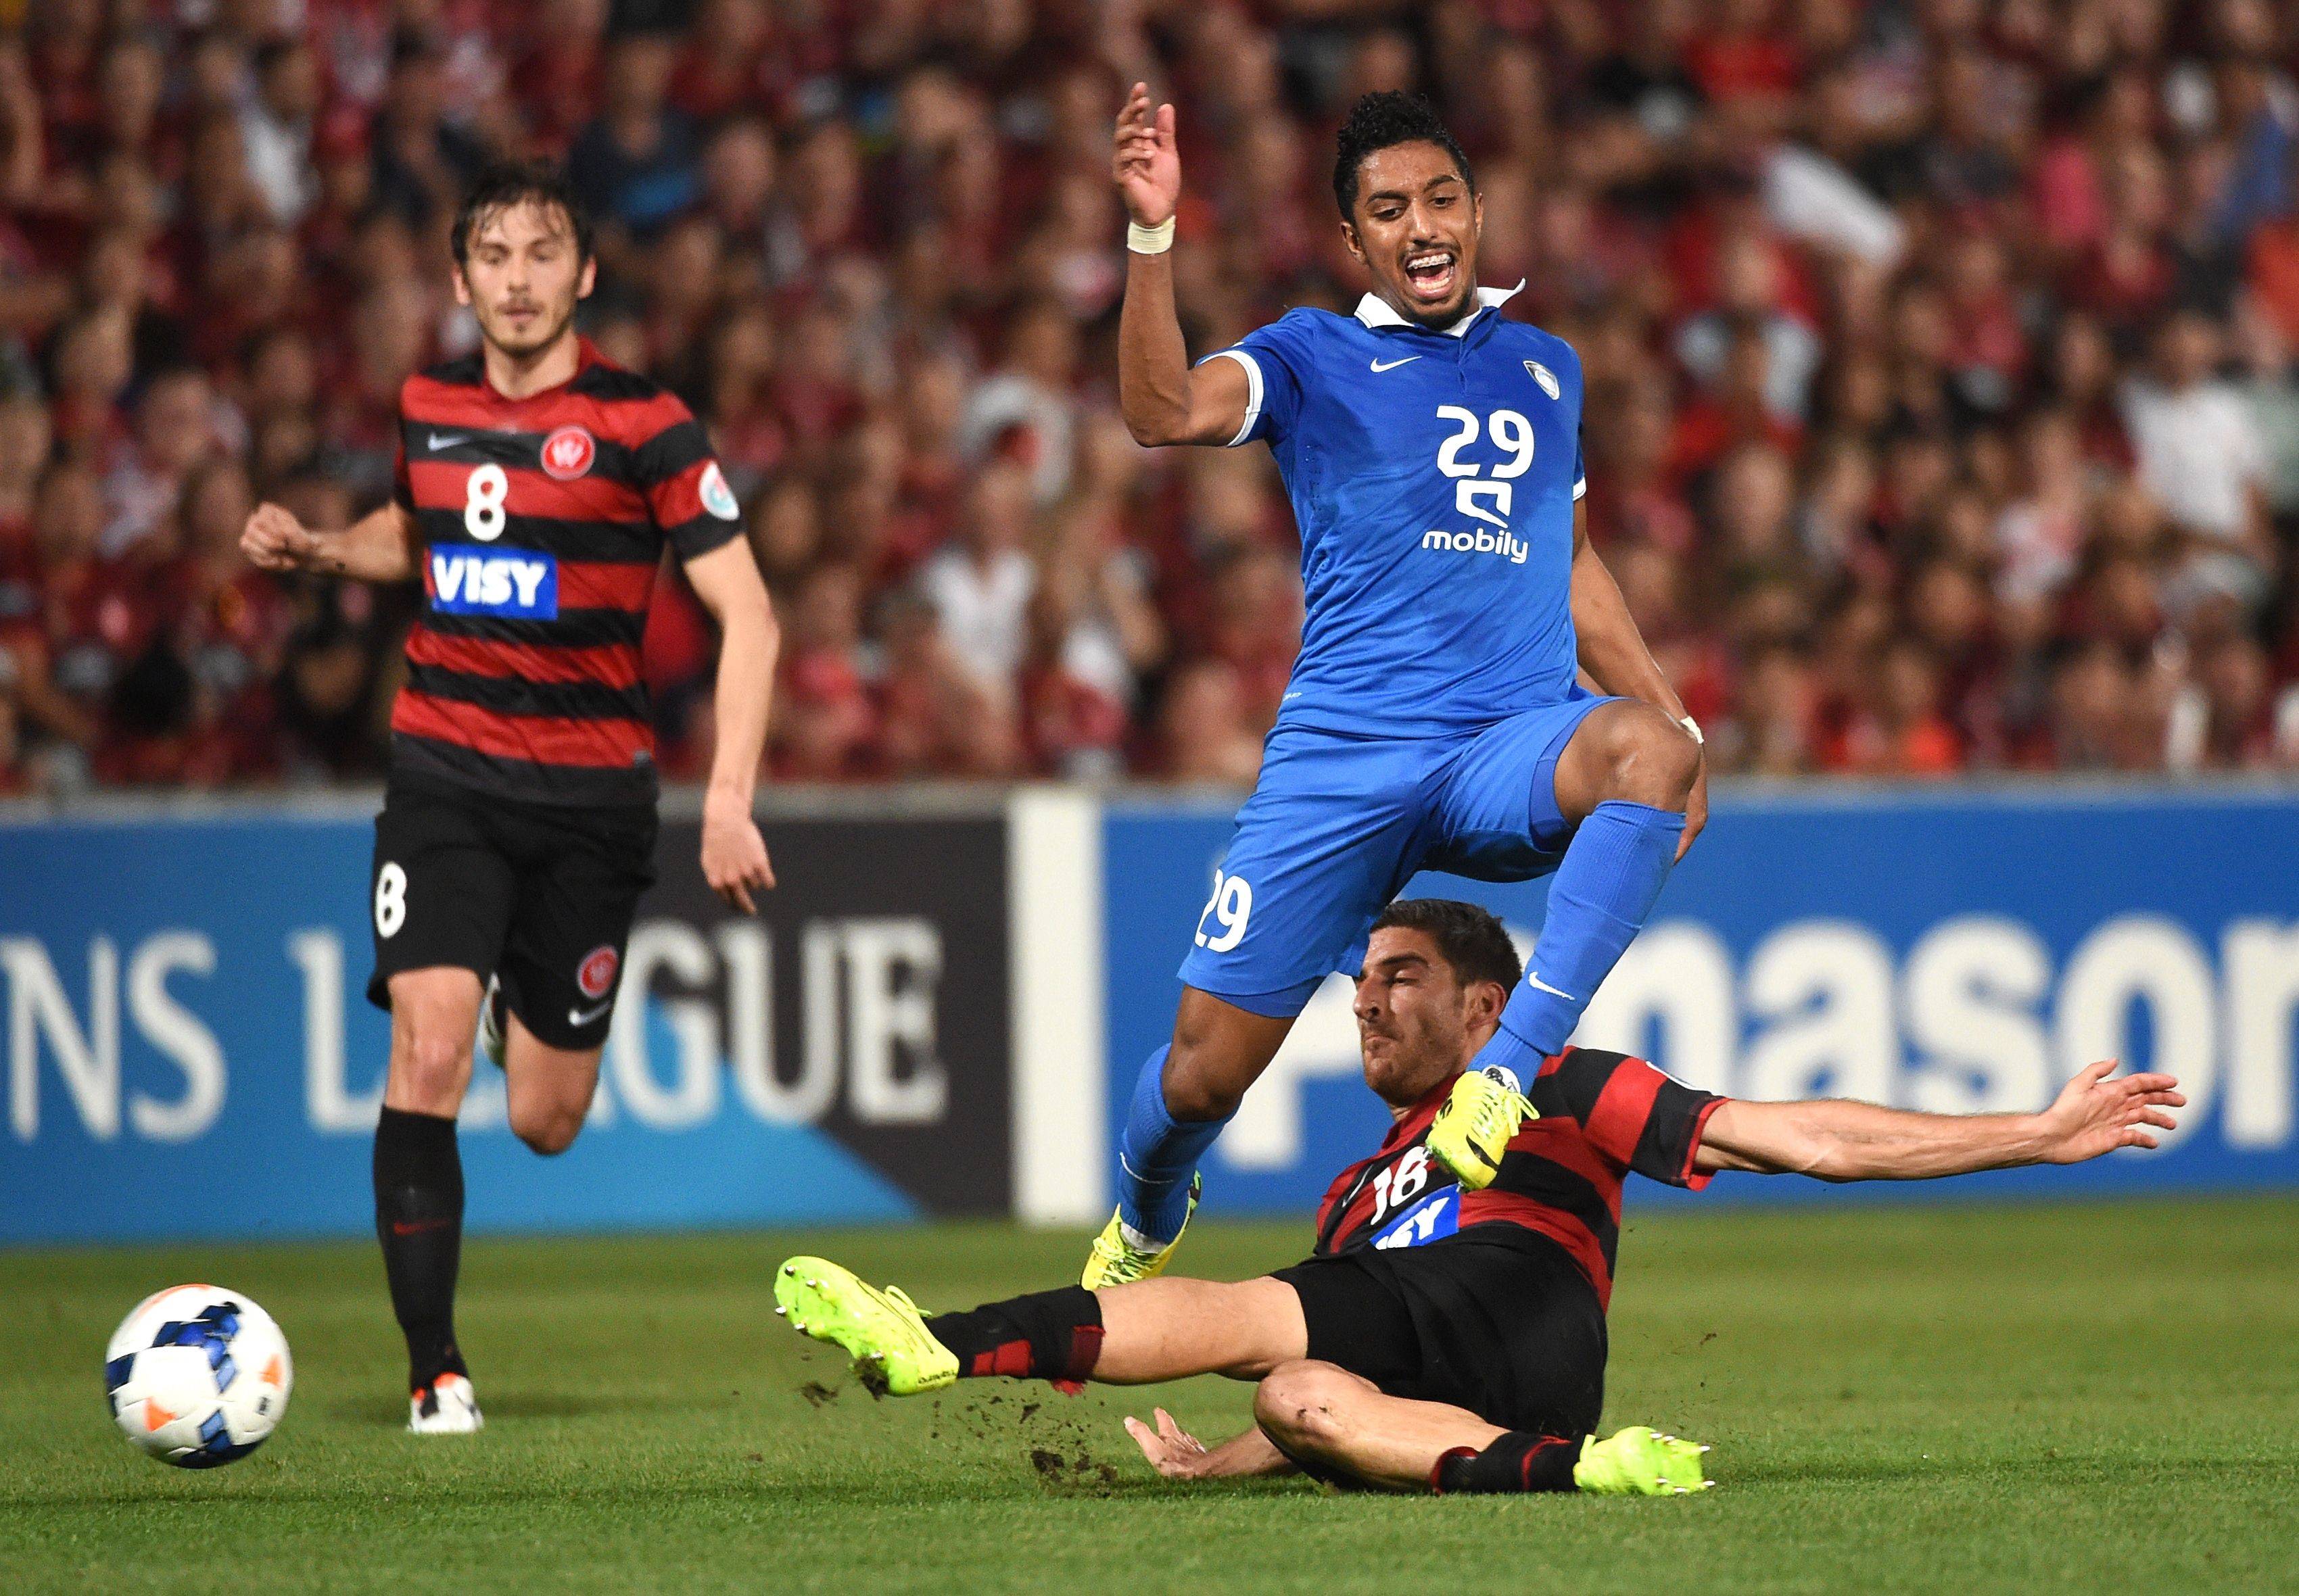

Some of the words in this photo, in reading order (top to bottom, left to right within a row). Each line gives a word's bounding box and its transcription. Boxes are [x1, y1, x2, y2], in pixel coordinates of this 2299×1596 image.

[1436, 405, 1535, 479] 29
[464, 463, 508, 541] 8
[432, 554, 547, 608] VISY
[1421, 527, 1529, 564] mobily
[375, 861, 407, 939] 8
[283, 916, 947, 1137] LGUE
